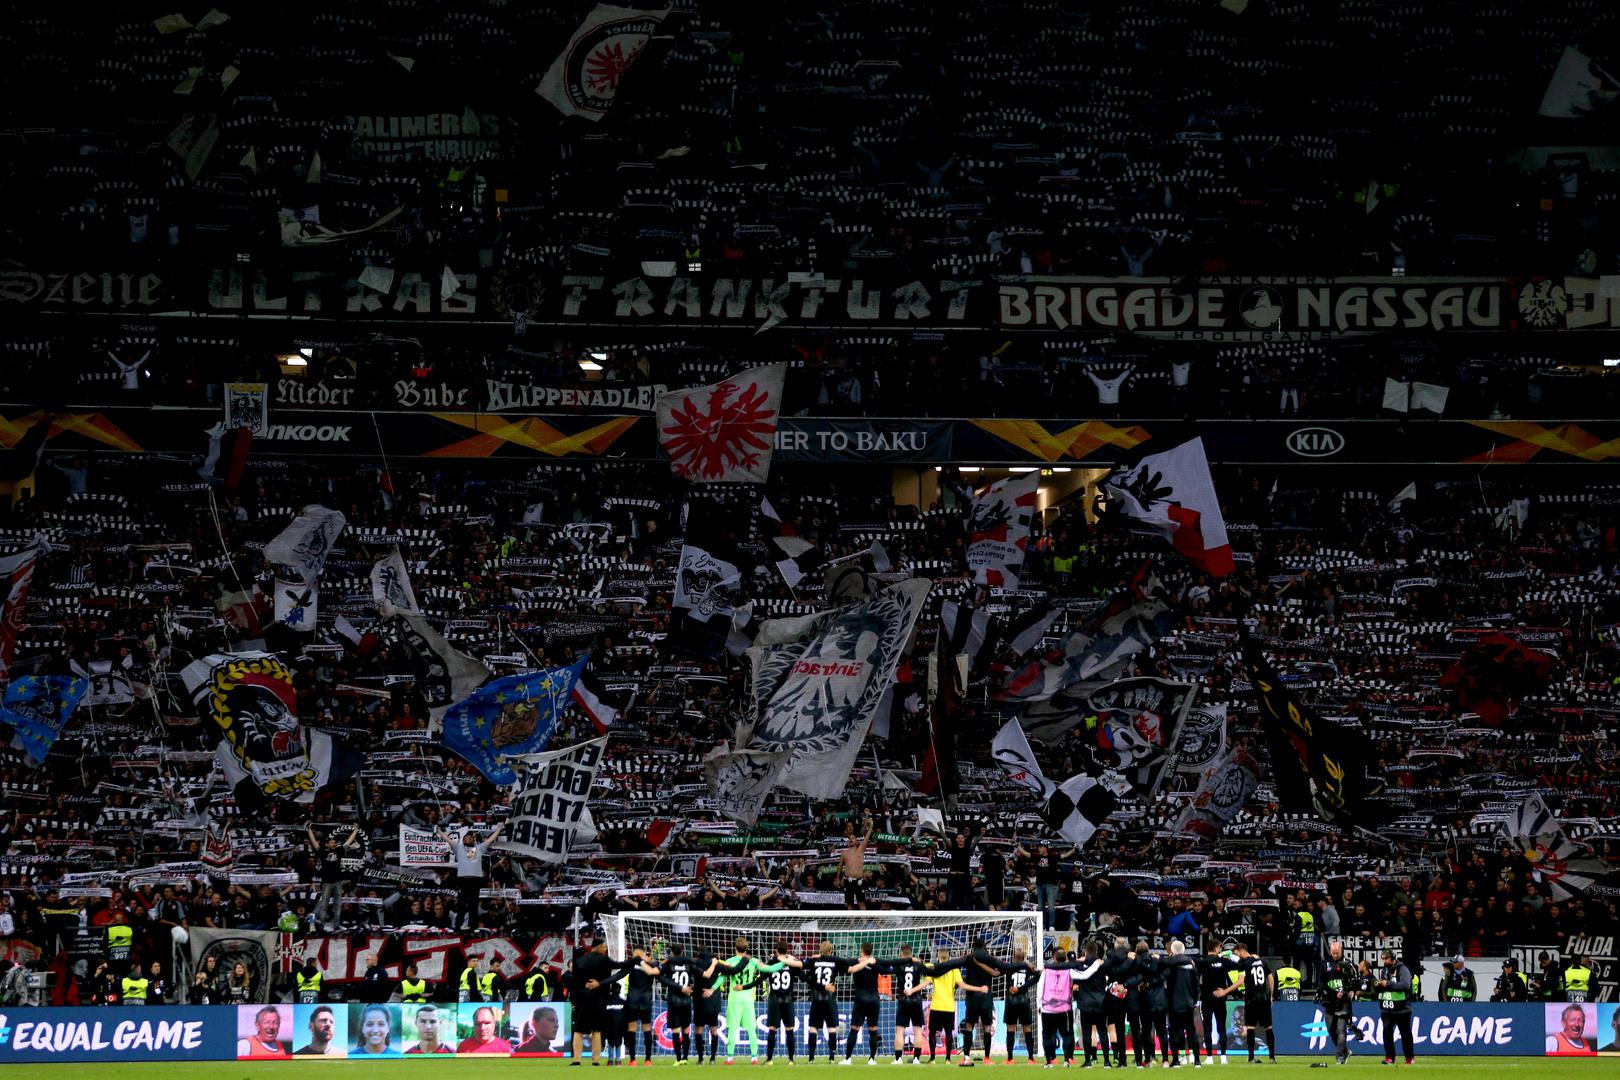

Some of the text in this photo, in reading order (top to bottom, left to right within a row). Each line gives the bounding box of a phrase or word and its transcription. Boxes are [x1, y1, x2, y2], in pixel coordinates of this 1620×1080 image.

[1000, 285, 1502, 335] BRIGADE NASSAU
[274, 378, 355, 406] Nieder
[816, 431, 849, 452] TO
[856, 431, 929, 452] BAKU
[1295, 434, 1337, 451] KIA
[671, 970, 690, 990] 10
[771, 970, 792, 990] 39
[814, 966, 833, 985] 13
[903, 972, 914, 989] 8
[1010, 972, 1027, 988] 15
[1250, 965, 1266, 987] 19
[111, 1020, 204, 1051] GAME
[1429, 1015, 1513, 1048] GAME
